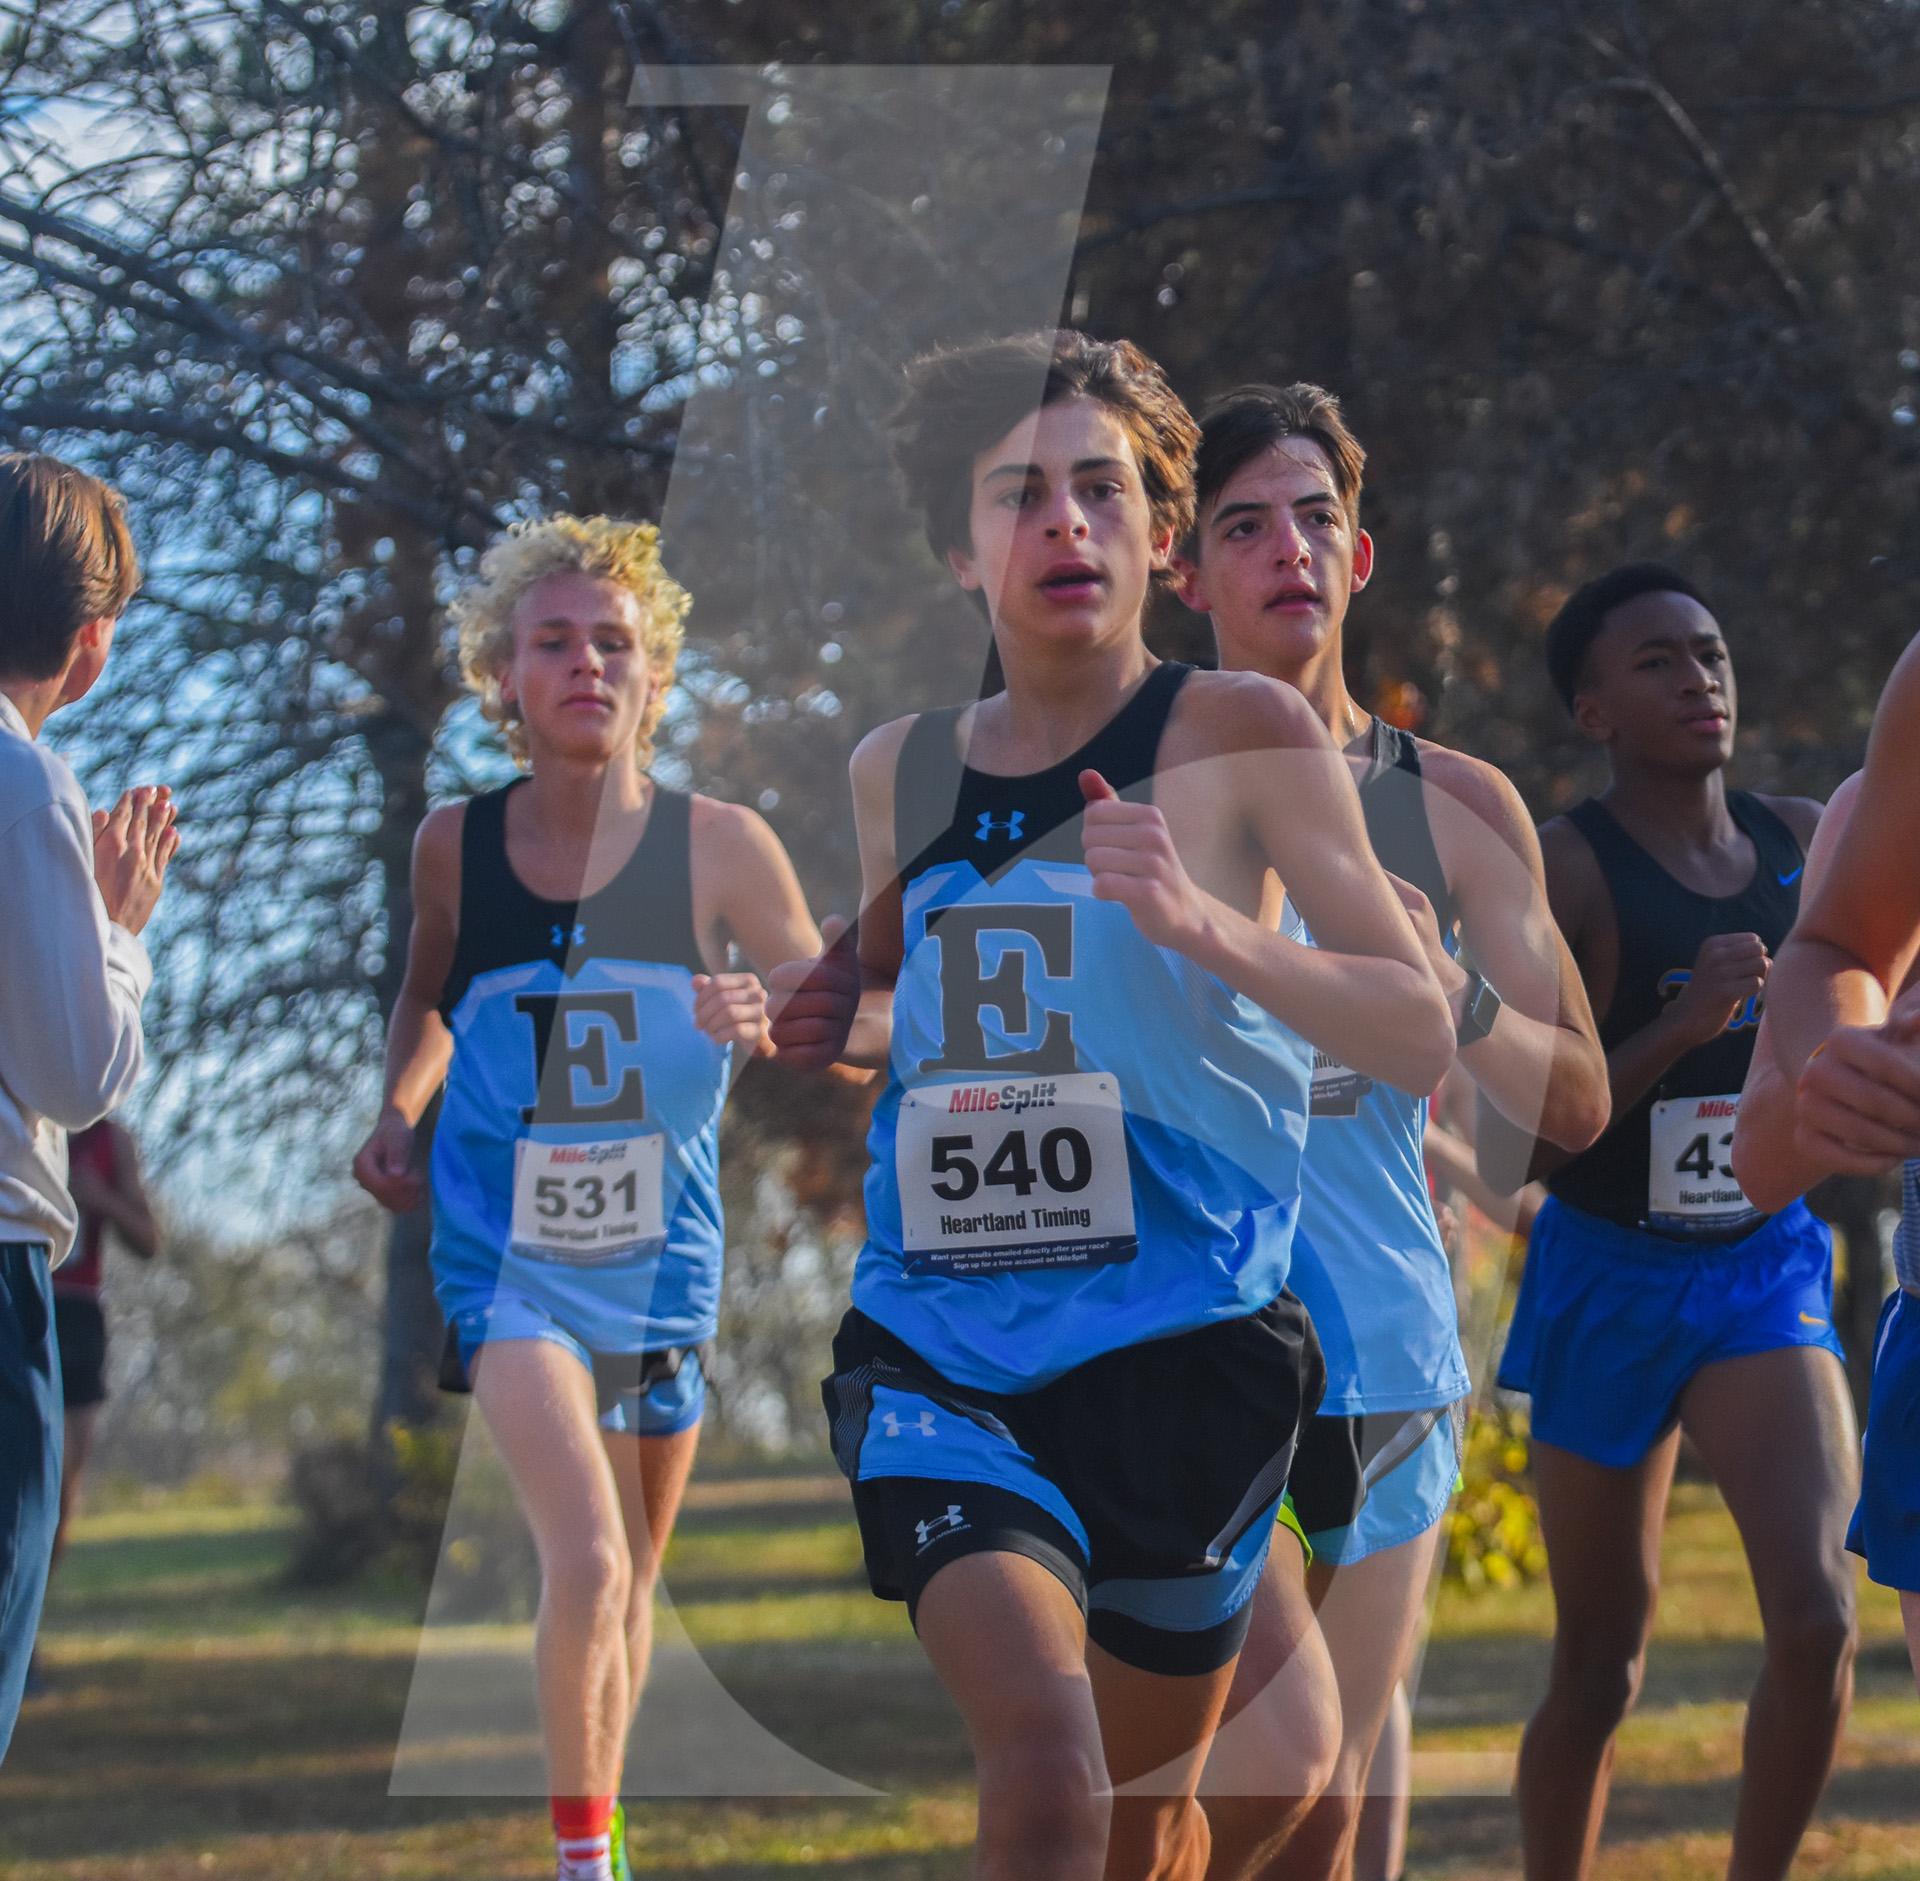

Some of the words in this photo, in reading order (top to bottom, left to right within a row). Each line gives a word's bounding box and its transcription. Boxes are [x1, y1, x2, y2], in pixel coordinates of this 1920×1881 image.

[916, 902, 1083, 1076] E
[514, 989, 645, 1126] E
[948, 1082, 1057, 1114] MileSplit
[1697, 1100, 1737, 1118] Mile
[931, 1127, 1093, 1201] 540
[534, 1169, 638, 1219] 531
[1679, 1189, 1743, 1205] Heartland
[940, 1210, 1027, 1235] Heartland
[1031, 1207, 1092, 1229] Timing
[951, 1253, 967, 1261] your
[968, 1251, 992, 1259] results
[993, 1249, 1022, 1257] emailed
[1023, 1247, 1050, 1255] directly
[1052, 1245, 1070, 1253] after
[1071, 1244, 1087, 1252] your
[1089, 1241, 1110, 1249] race?
[953, 1261, 970, 1270] Sign
[971, 1261, 980, 1269] up
[1014, 1256, 1044, 1265] account
